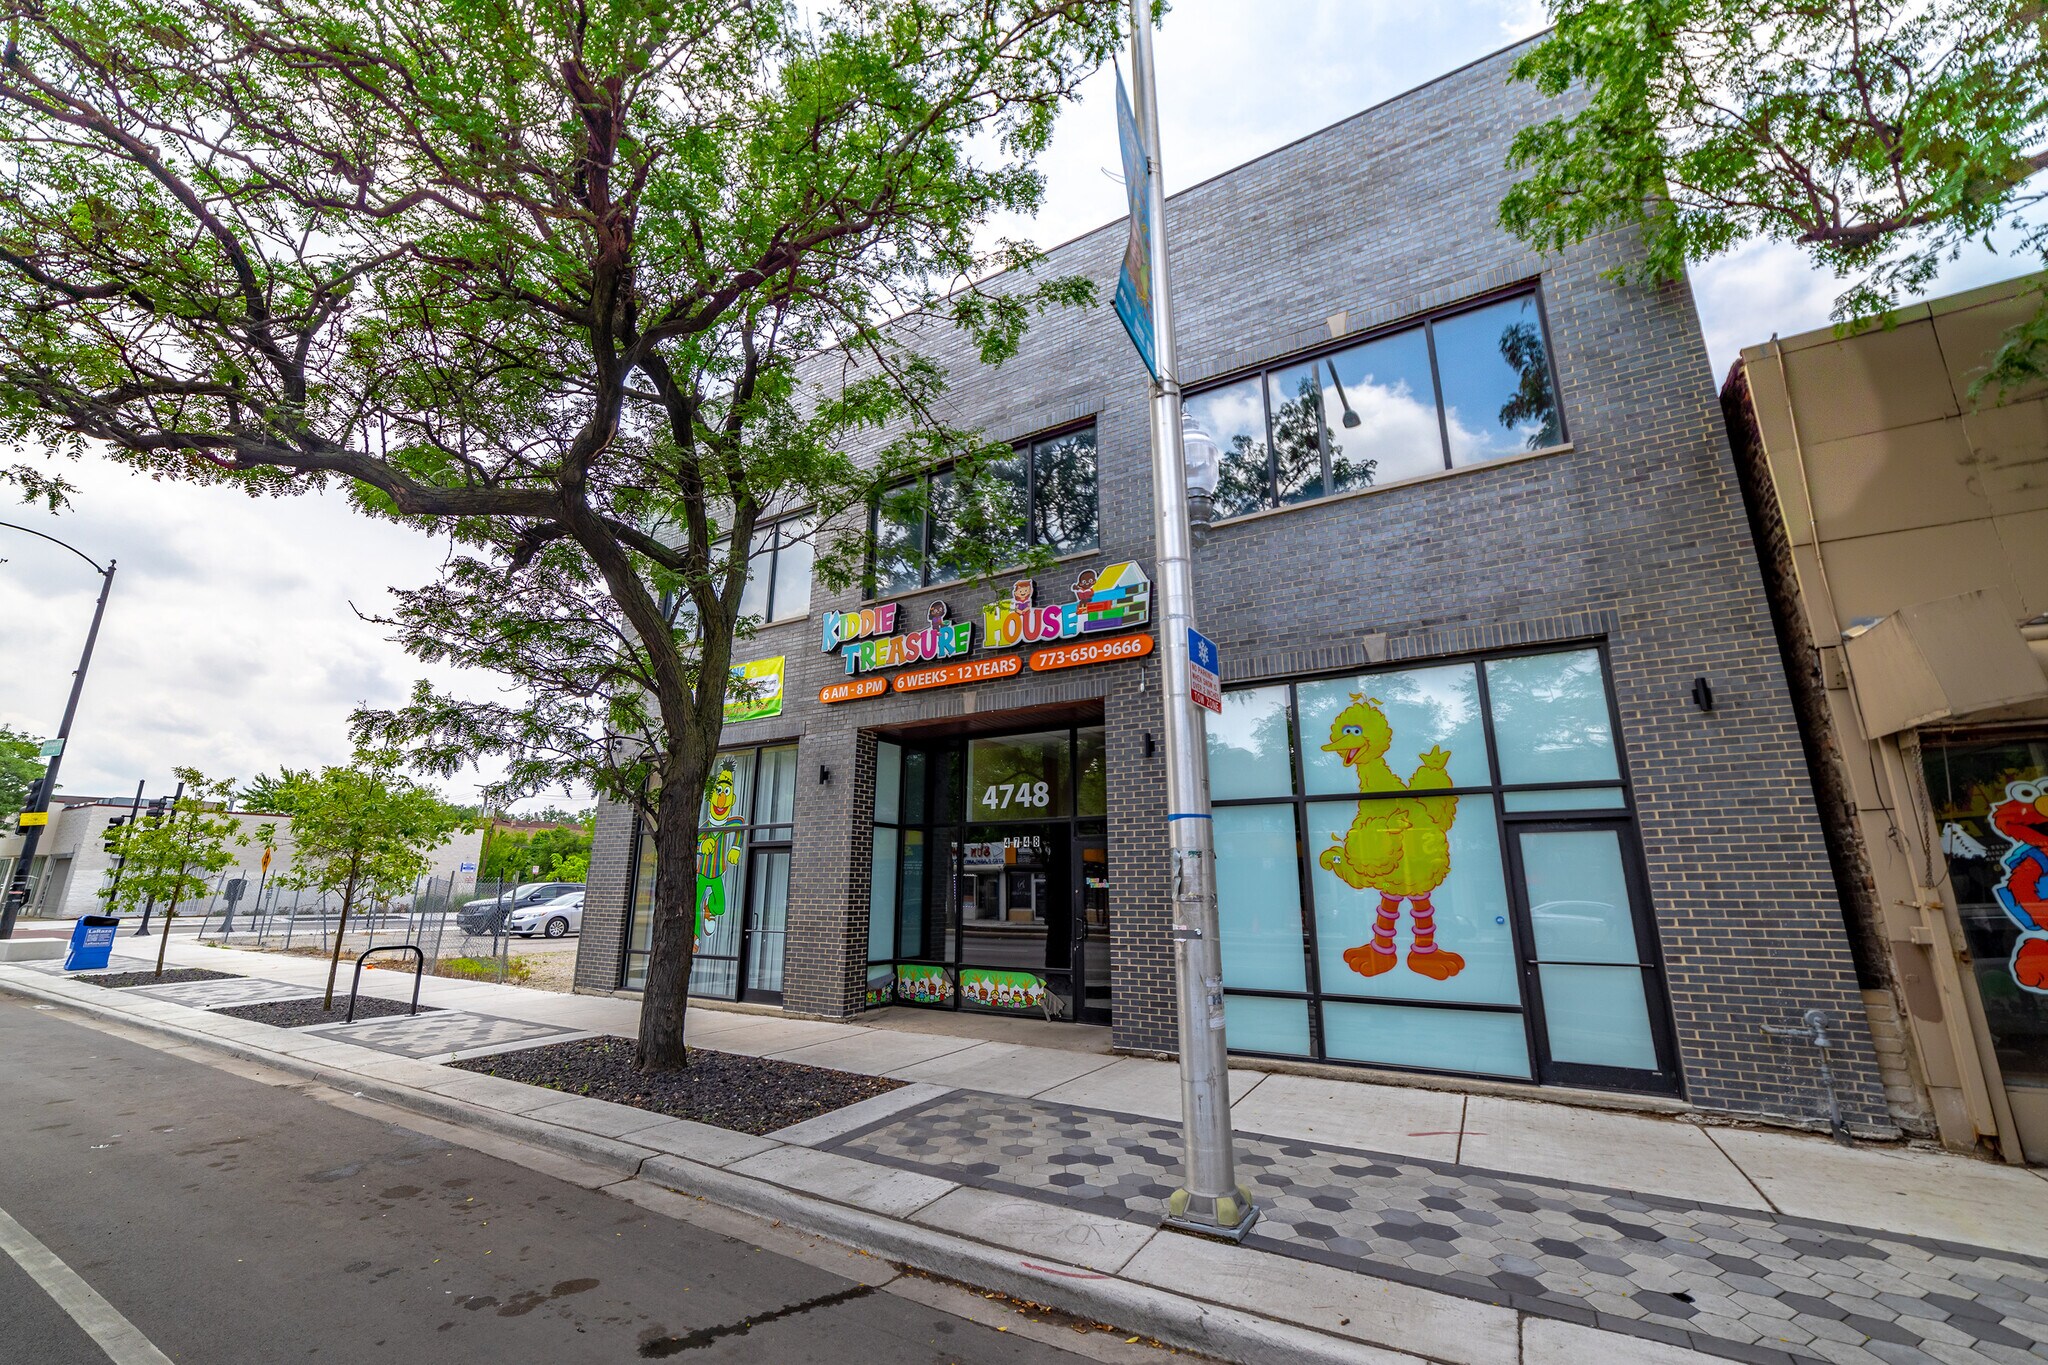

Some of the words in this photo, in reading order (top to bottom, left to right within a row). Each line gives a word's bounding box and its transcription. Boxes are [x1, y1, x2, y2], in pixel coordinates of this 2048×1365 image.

[822, 604, 897, 652] KIDDIE
[842, 622, 971, 674] TREASURE
[984, 600, 1079, 648] HOUSE
[1040, 639, 1141, 667] 773-650-9666
[897, 678, 904, 689] 6
[906, 670, 947, 687] WEEKS
[957, 666, 972, 680] 12
[974, 658, 1016, 676] YEARS
[823, 688, 829, 700] 6
[831, 686, 848, 698] AM
[856, 682, 863, 695] 8
[865, 680, 883, 693] PM
[1194, 691, 1204, 705] TOW
[1206, 697, 1219, 711] ZONE
[982, 781, 1049, 810] 4748
[1004, 836, 1039, 848] 4748
